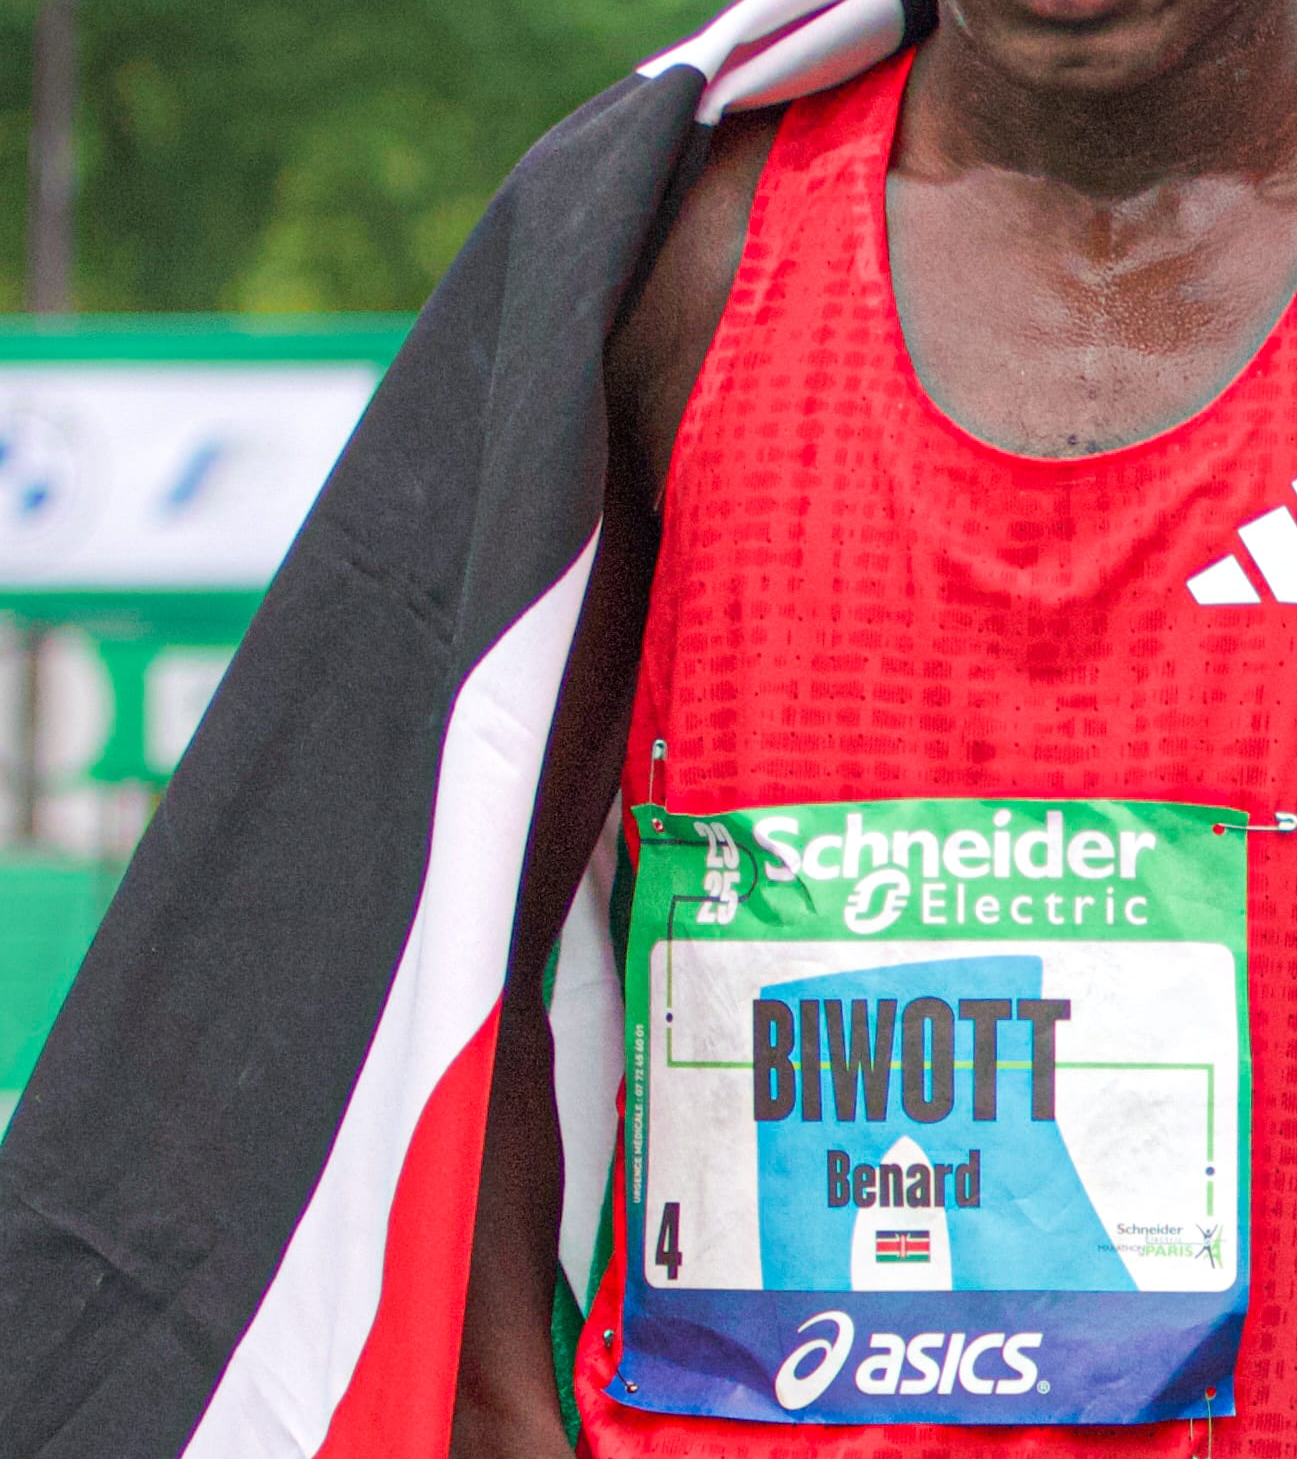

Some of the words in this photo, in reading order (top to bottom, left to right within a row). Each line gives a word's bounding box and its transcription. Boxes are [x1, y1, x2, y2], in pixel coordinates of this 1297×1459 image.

[753, 809, 1157, 882] Schneider
[695, 870, 741, 926] 25
[921, 883, 1148, 926] Electric
[752, 996, 1072, 1124] BIWOTT
[826, 1149, 981, 1208] Benard
[654, 1201, 682, 1280] 4
[1116, 1223, 1184, 1235] Schneider
[1146, 1245, 1194, 1257] PARIS
